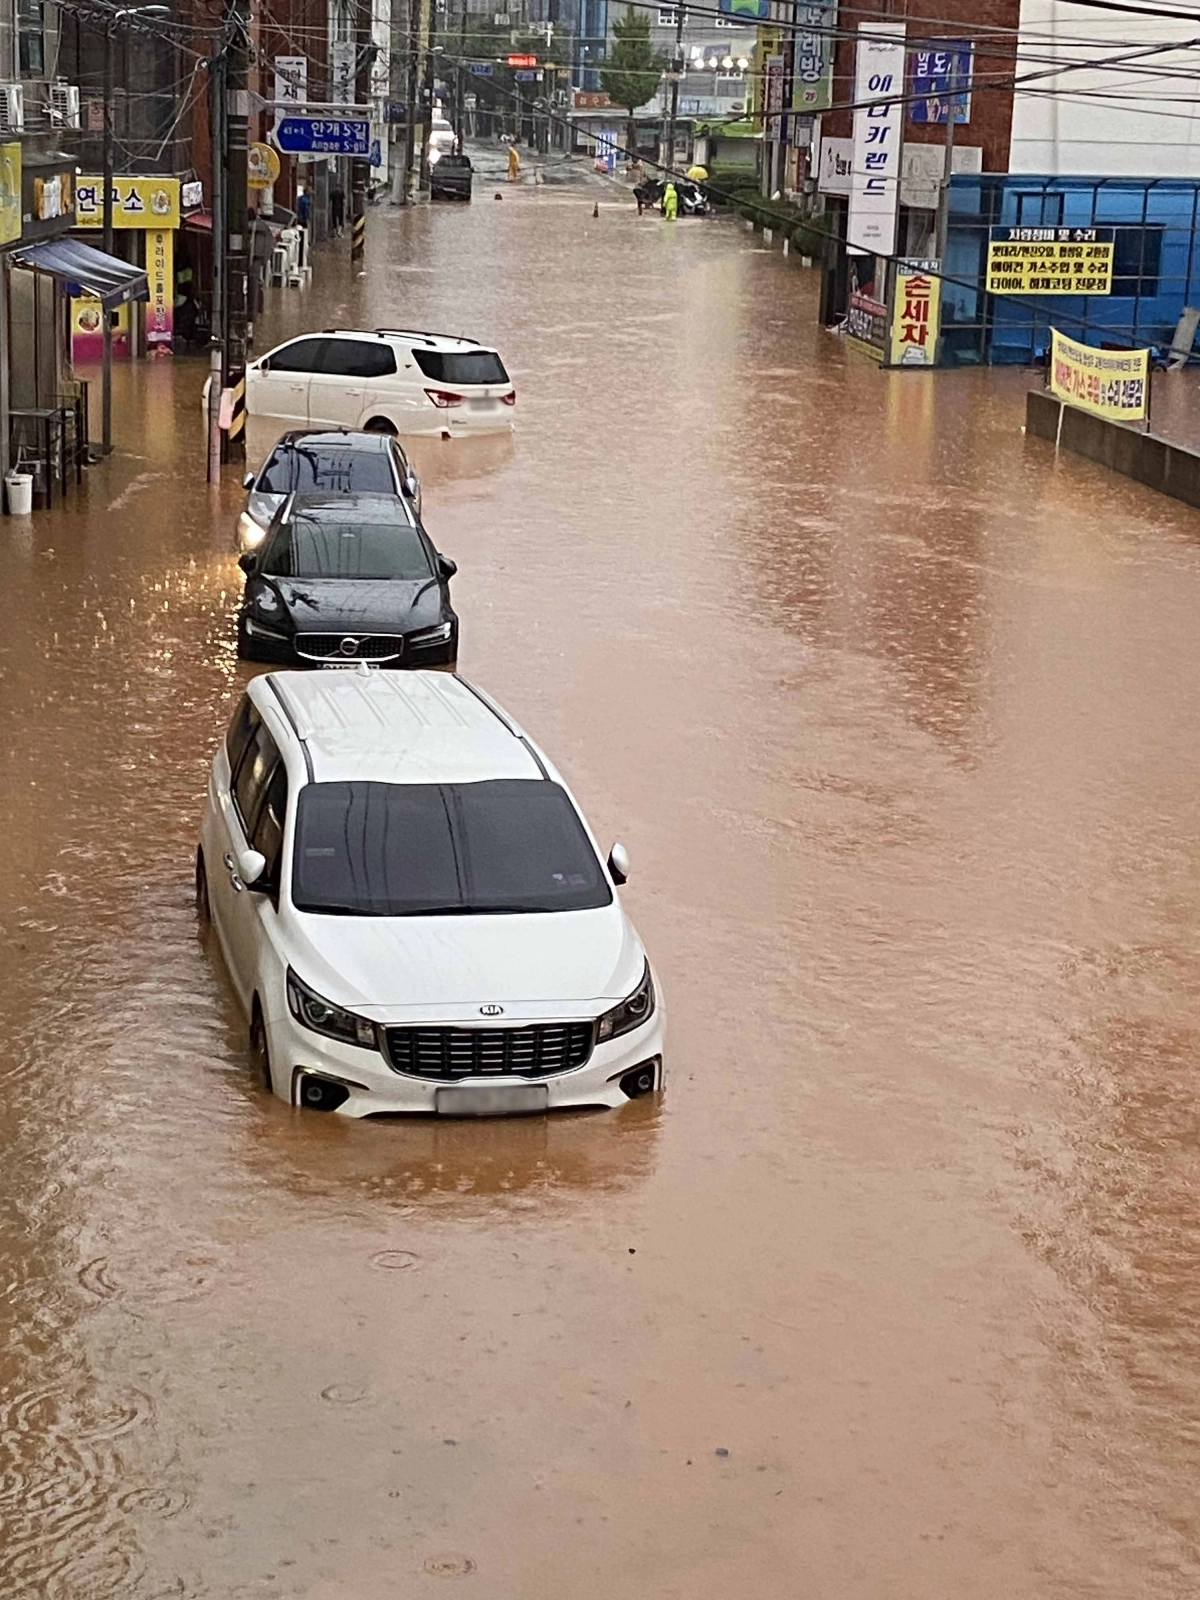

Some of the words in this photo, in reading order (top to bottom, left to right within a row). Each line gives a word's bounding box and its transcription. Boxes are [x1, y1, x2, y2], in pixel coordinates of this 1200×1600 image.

[311, 121, 366, 140] 안개5길
[311, 140, 340, 151] Angae
[1058, 229, 1070, 241] 및
[1073, 229, 1096, 241] 수리
[991, 261, 1023, 273] 에어컨
[1073, 262, 1084, 274] 및
[1088, 262, 1108, 274] 수리
[899, 275, 931, 345] 손세차
[482, 1006, 502, 1015] KIA
